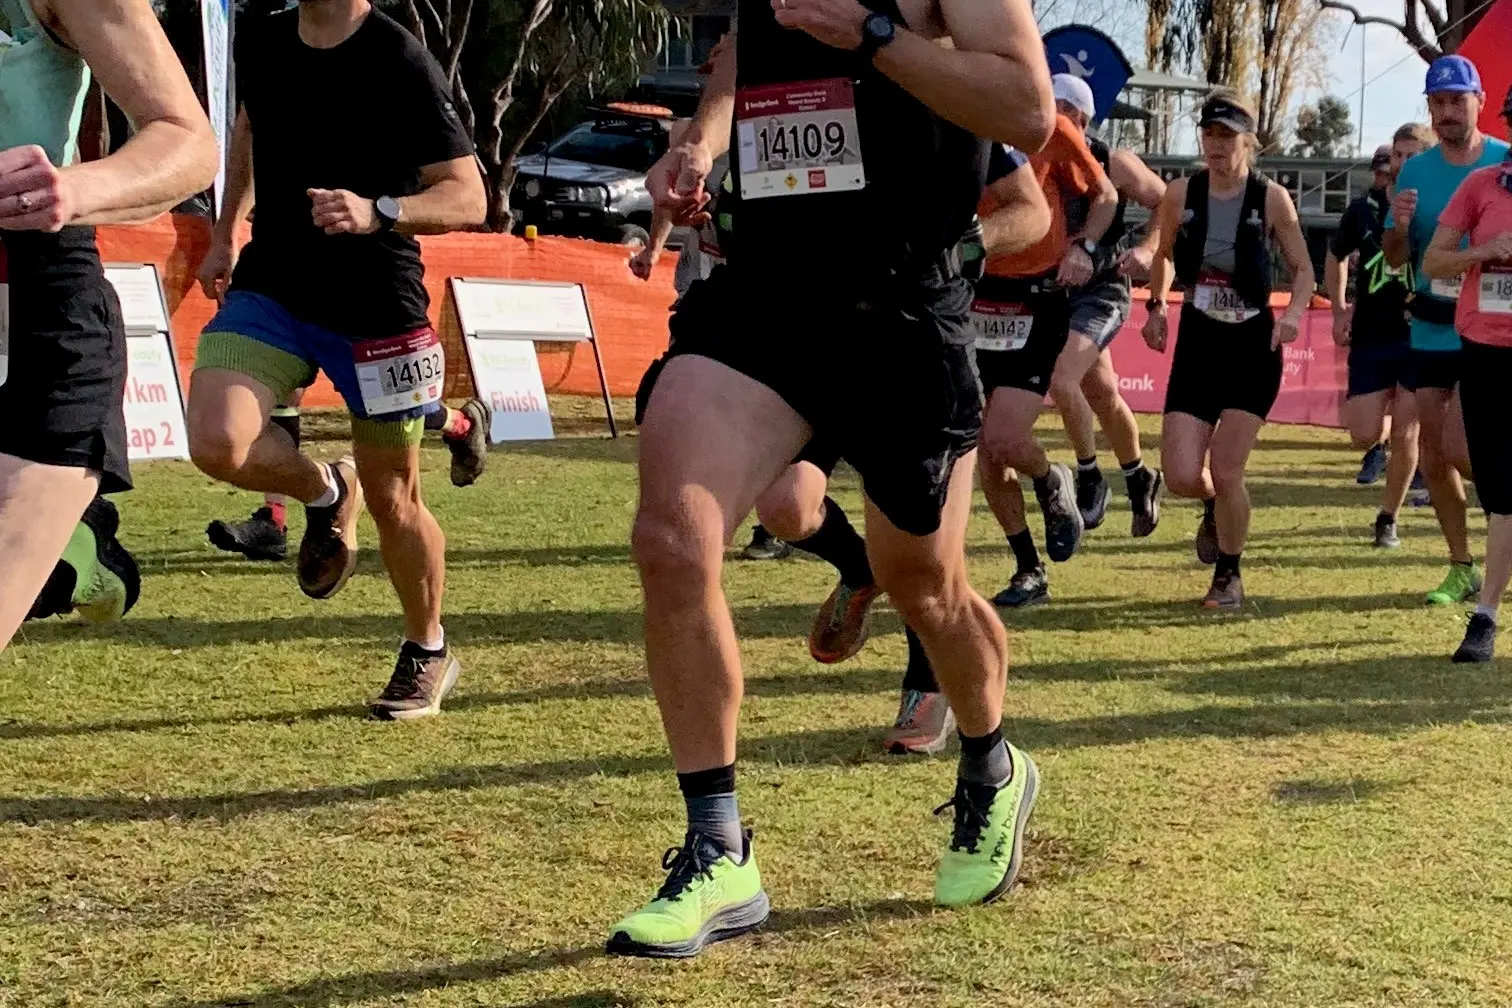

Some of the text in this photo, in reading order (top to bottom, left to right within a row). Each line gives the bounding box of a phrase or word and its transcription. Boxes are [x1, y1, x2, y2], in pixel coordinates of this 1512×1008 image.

[760, 121, 845, 162] 14109
[387, 353, 441, 388] 14132
[1115, 372, 1154, 391] ank
[490, 390, 540, 413] Finish
[127, 421, 175, 454] ap 2
[990, 832, 1007, 864] new
